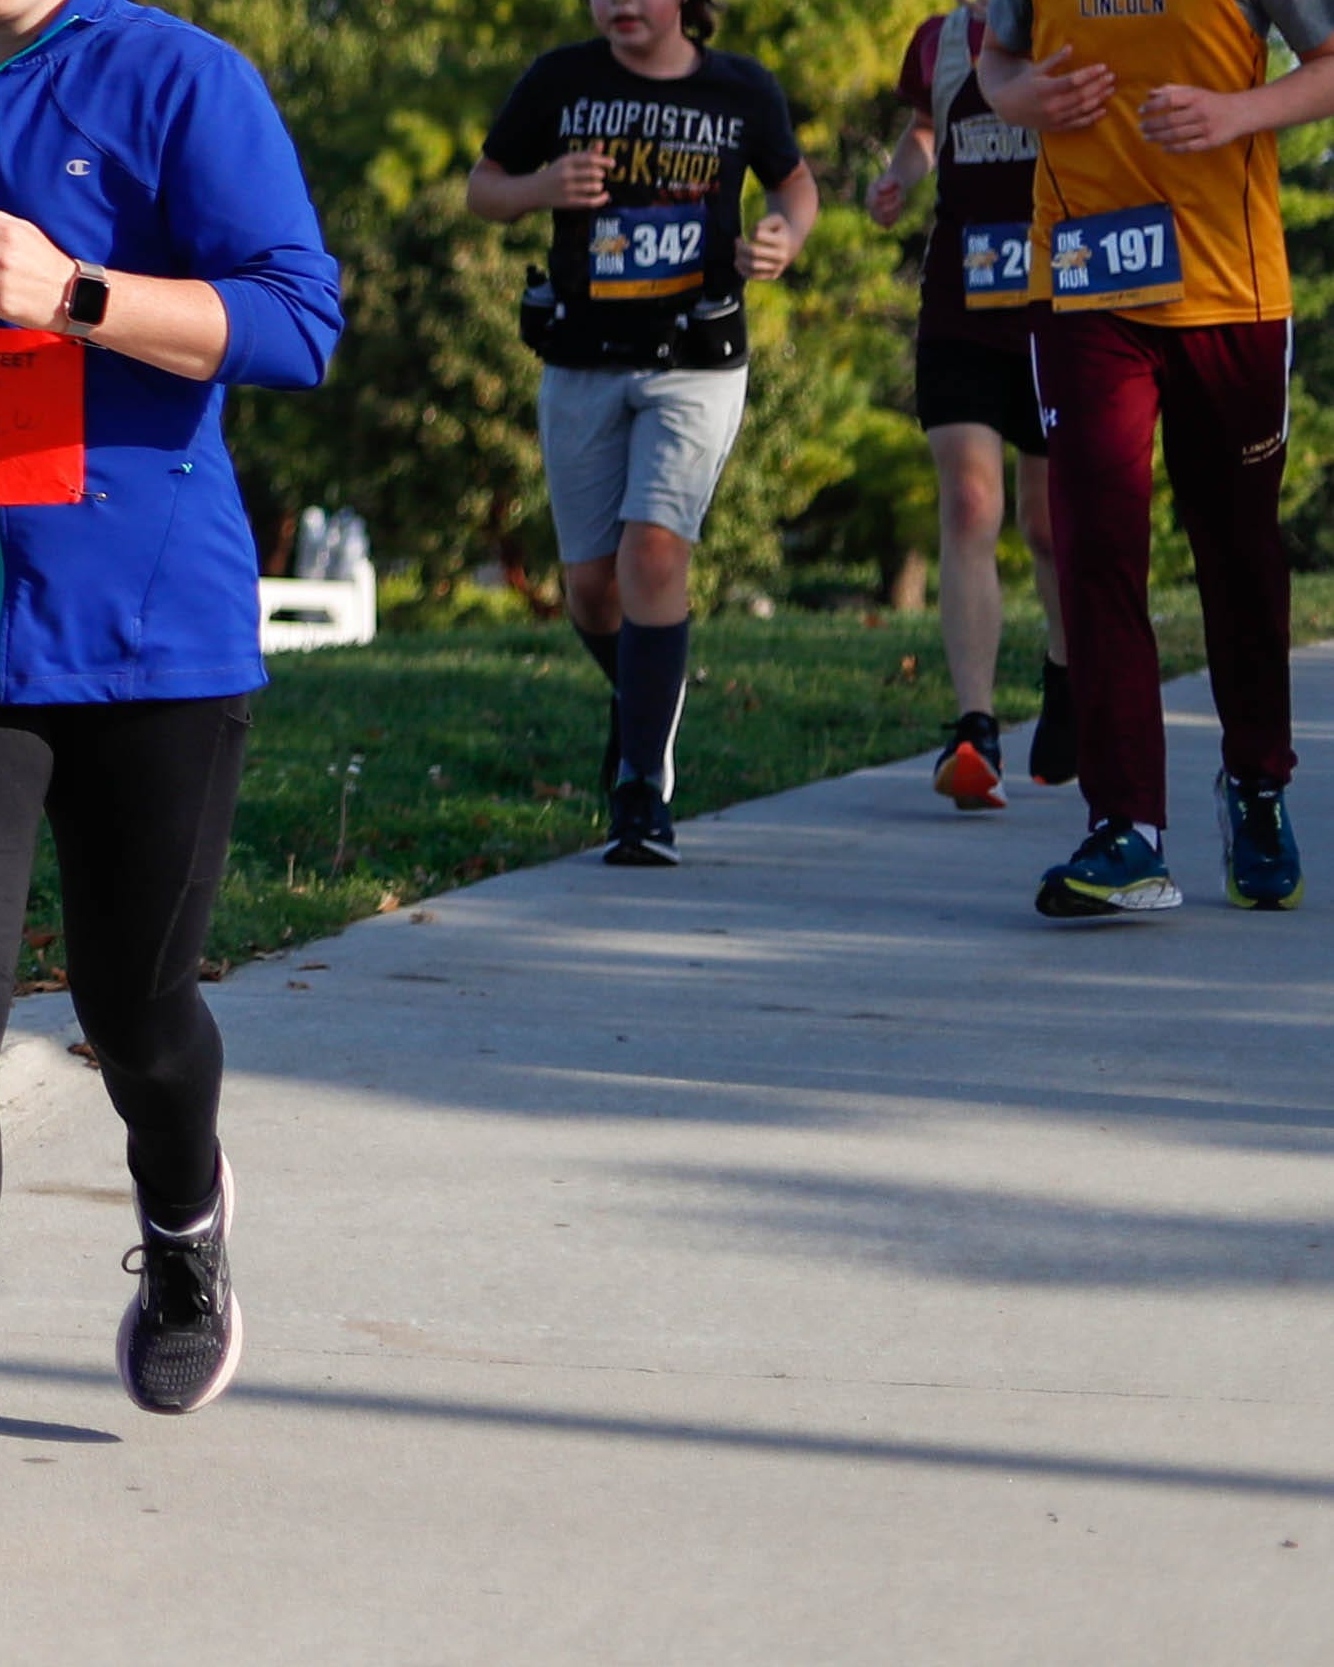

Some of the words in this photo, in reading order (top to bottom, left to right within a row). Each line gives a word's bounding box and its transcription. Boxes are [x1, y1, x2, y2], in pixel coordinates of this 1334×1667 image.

[633, 221, 702, 267] 342
[1057, 229, 1084, 252] ONE
[1099, 224, 1165, 275] 197
[1059, 267, 1090, 289] RUN
